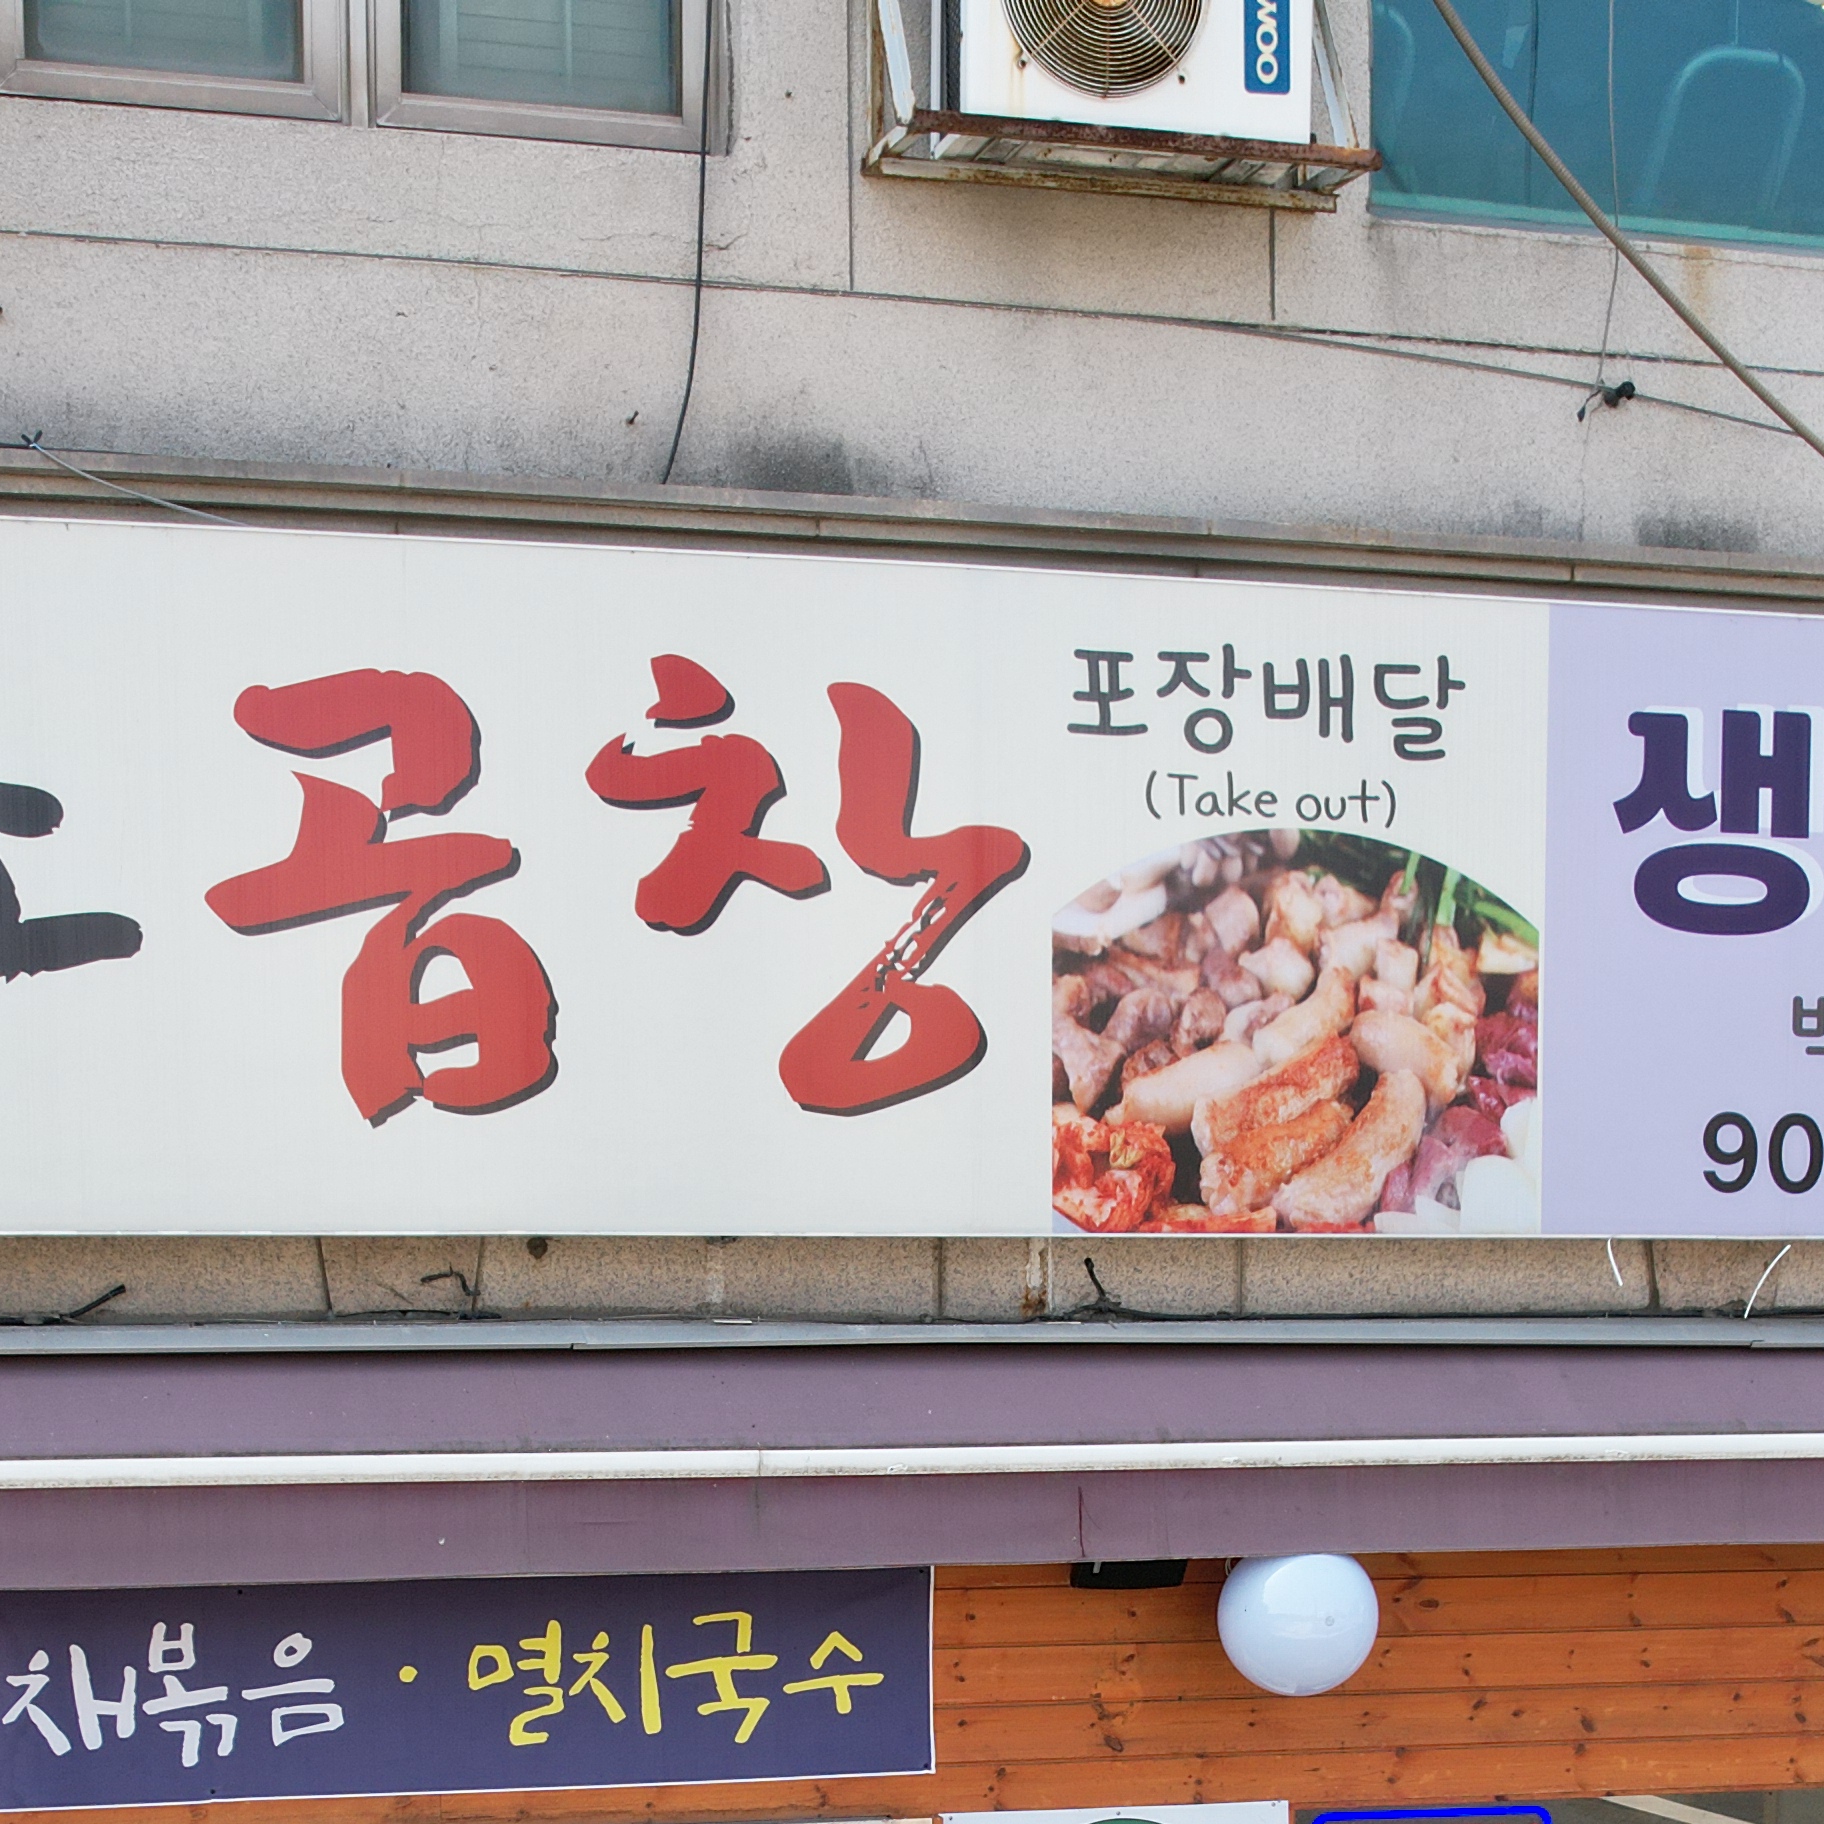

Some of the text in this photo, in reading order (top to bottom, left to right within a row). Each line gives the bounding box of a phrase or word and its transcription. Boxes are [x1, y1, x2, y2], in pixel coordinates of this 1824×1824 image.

[1066, 643, 1465, 762] 포장배달
[1145, 772, 1397, 828] (Take out)
[205, 653, 1032, 1128] 곱창
[467, 1612, 885, 1748] 멸치국수
